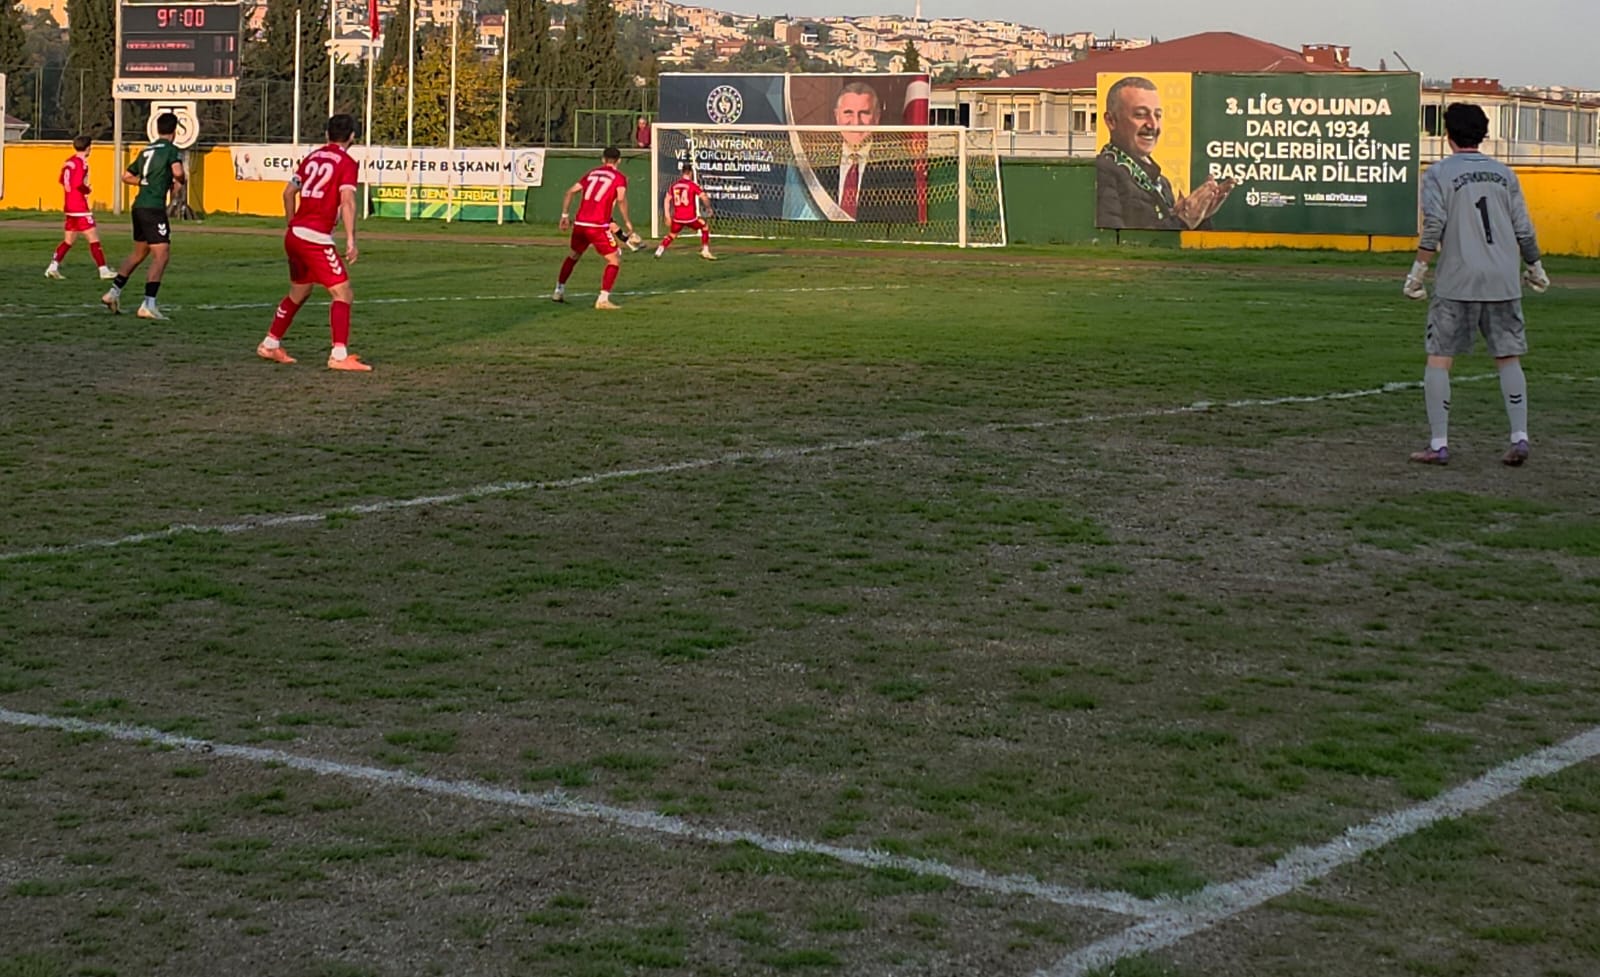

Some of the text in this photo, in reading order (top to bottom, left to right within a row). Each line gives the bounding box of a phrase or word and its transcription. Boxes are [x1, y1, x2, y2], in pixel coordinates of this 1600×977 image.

[1225, 92, 1392, 115] 3. LİG YOLUNDA
[1246, 120, 1370, 138] DARICA 1934
[675, 149, 687, 160] VE
[1206, 138, 1411, 163] GENÇLERBİRLİĞİ'NE
[141, 150, 155, 185] 7
[301, 161, 334, 198] 22
[1209, 162, 1407, 185] BAŞARILAR DİLERİM
[585, 176, 612, 202] 77
[1475, 196, 1494, 244] 1
